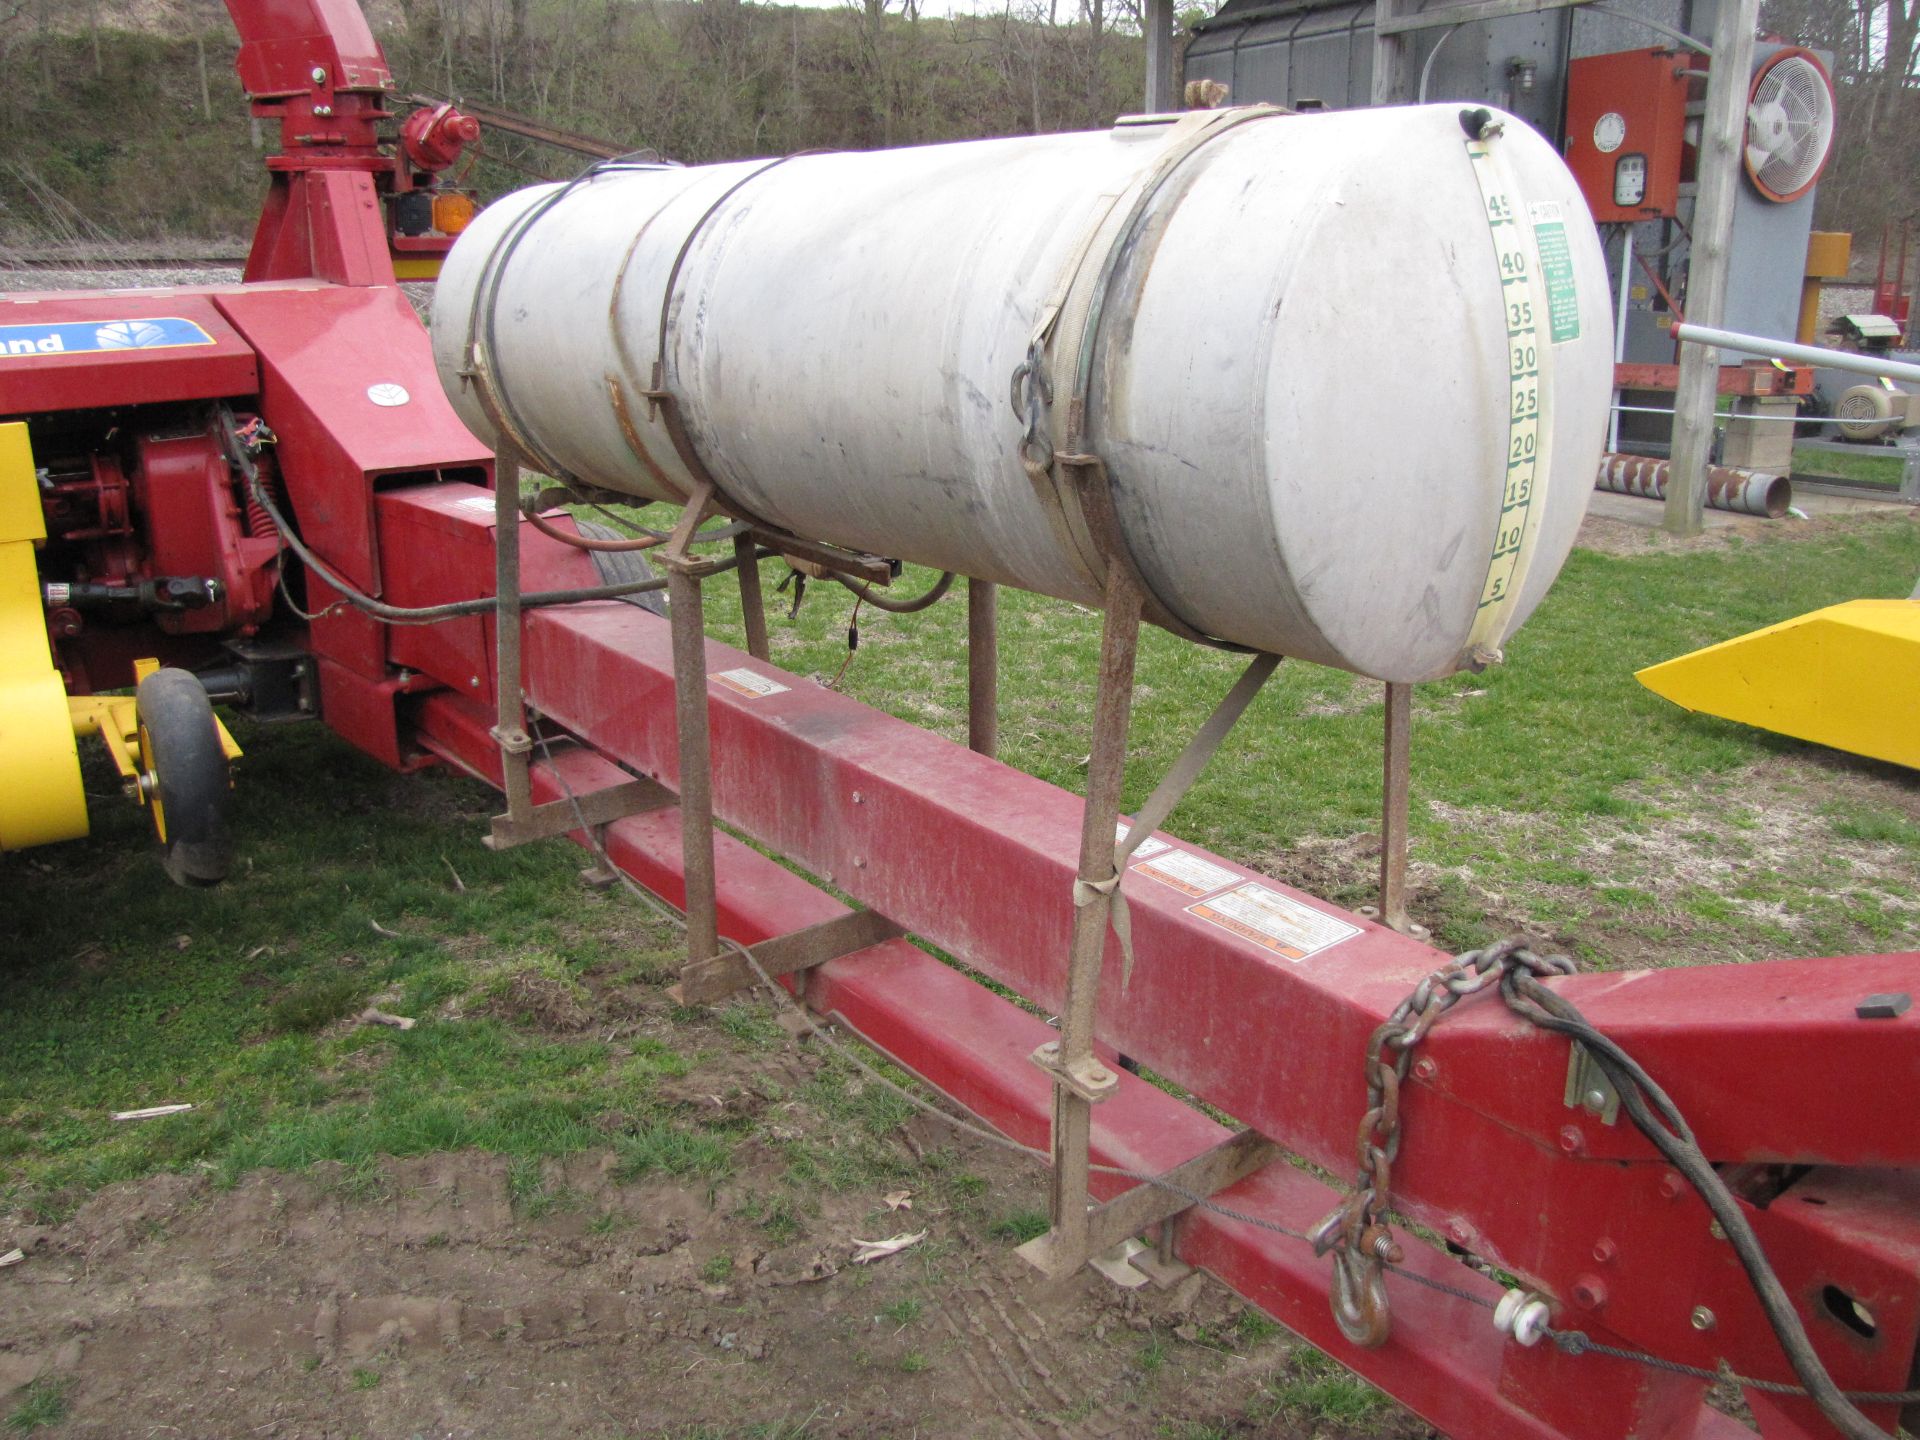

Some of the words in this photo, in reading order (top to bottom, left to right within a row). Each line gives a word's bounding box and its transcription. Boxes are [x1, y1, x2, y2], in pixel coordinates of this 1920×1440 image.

[1489, 195, 1511, 216] 45
[1502, 252, 1525, 274] 40
[1511, 302, 1532, 326] 35
[1514, 347, 1535, 371] 30
[1515, 389, 1536, 413] 25
[1513, 433, 1534, 458] 20
[1509, 480, 1529, 502] 15
[1500, 527, 1520, 550] 10
[1491, 578, 1502, 596] 5
[1211, 911, 1269, 942] WARNING
